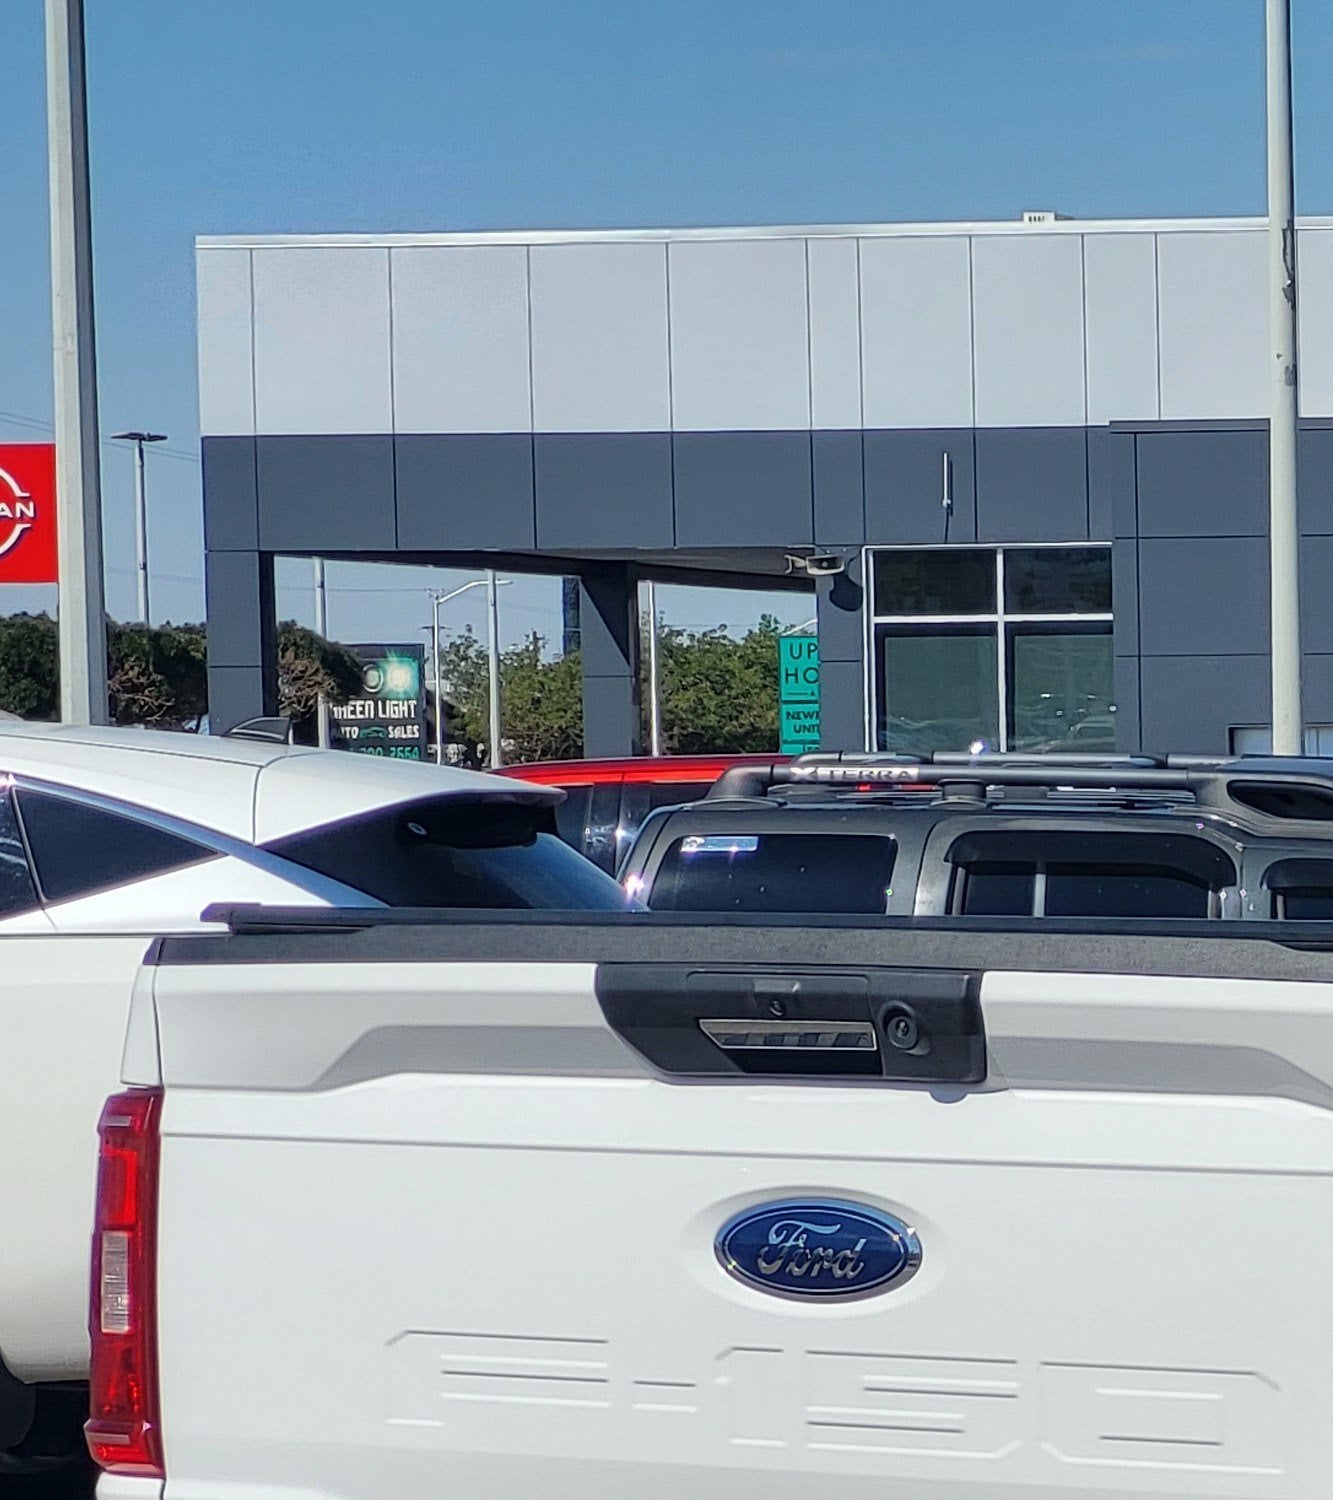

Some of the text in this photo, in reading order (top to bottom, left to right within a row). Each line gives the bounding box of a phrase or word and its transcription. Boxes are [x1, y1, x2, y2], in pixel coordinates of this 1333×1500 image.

[333, 700, 417, 719] REEN LIGHT
[341, 725, 420, 739] TO SALES
[790, 767, 917, 780] XTERRA
[757, 1220, 867, 1278] Ford
